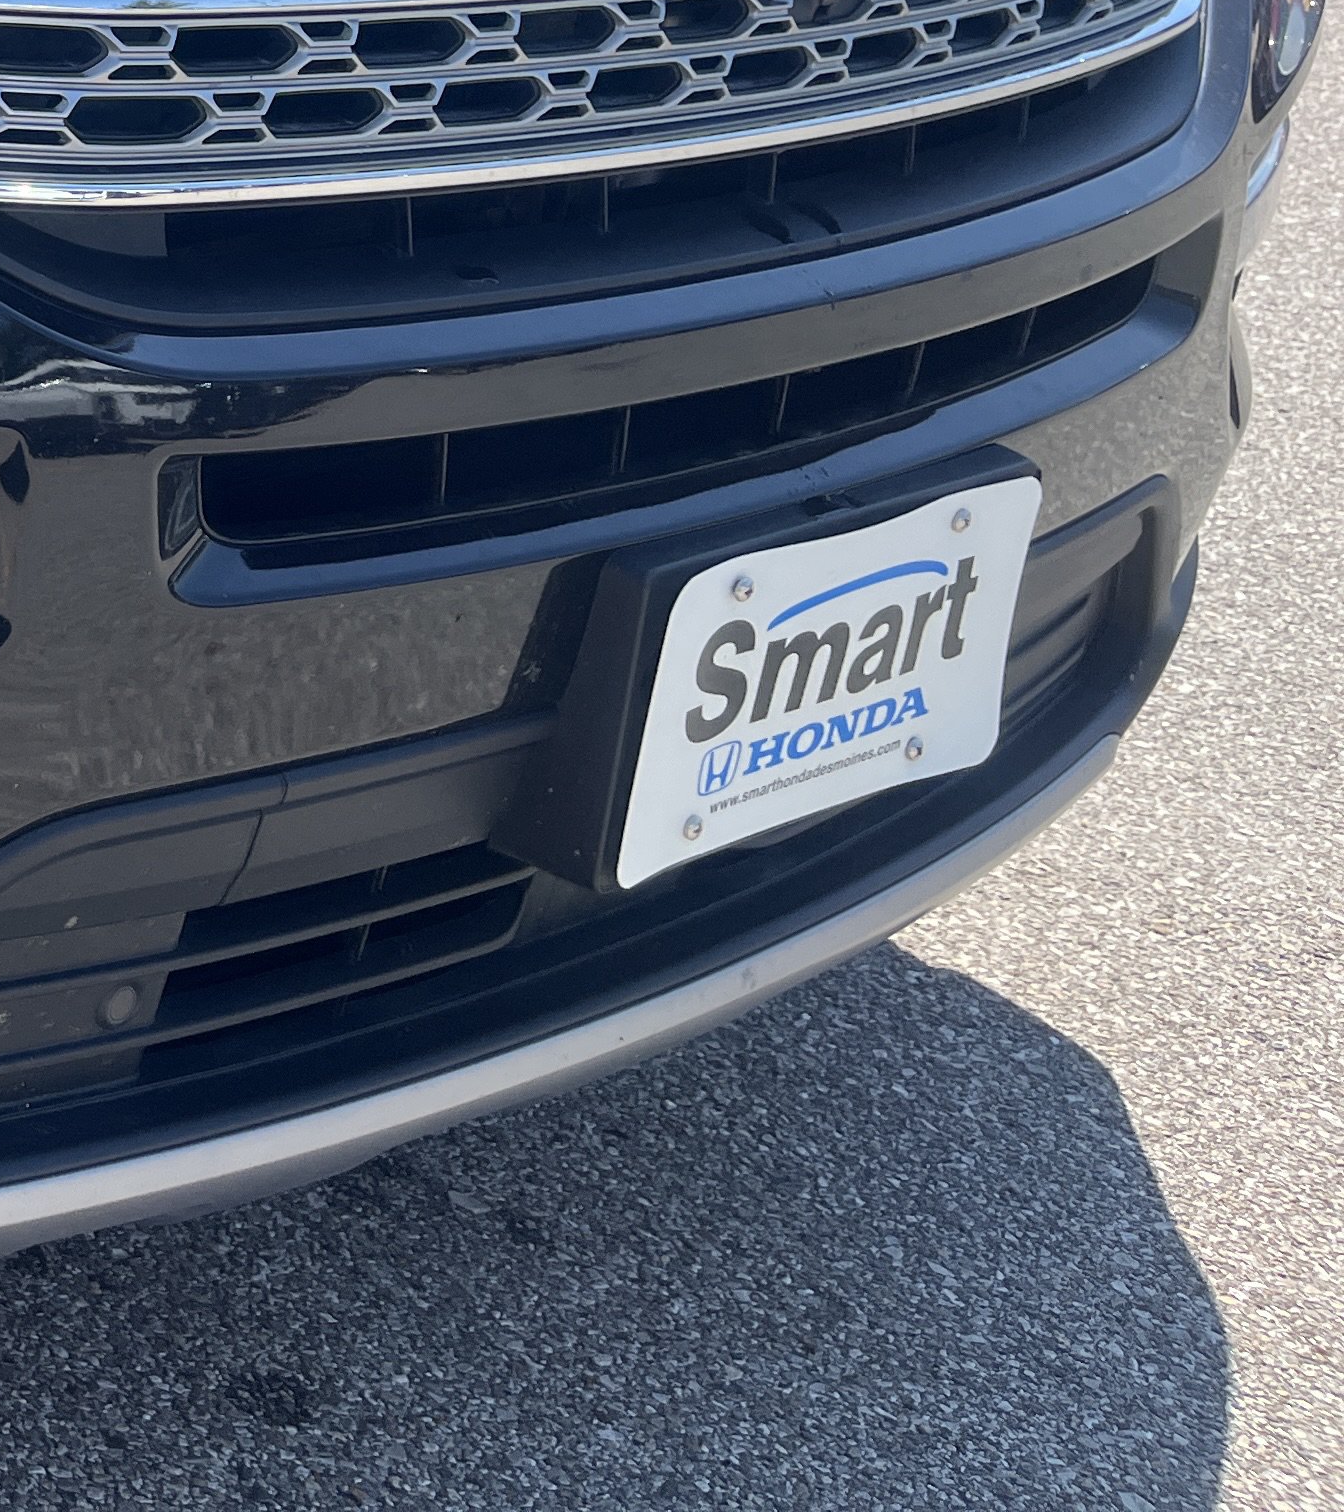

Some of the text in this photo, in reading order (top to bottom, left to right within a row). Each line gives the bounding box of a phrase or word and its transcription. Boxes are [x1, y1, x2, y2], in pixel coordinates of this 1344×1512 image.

[685, 556, 978, 744] Smart
[743, 687, 928, 776] HONDA
[709, 739, 901, 814] www.smarthondadesmoines.com
